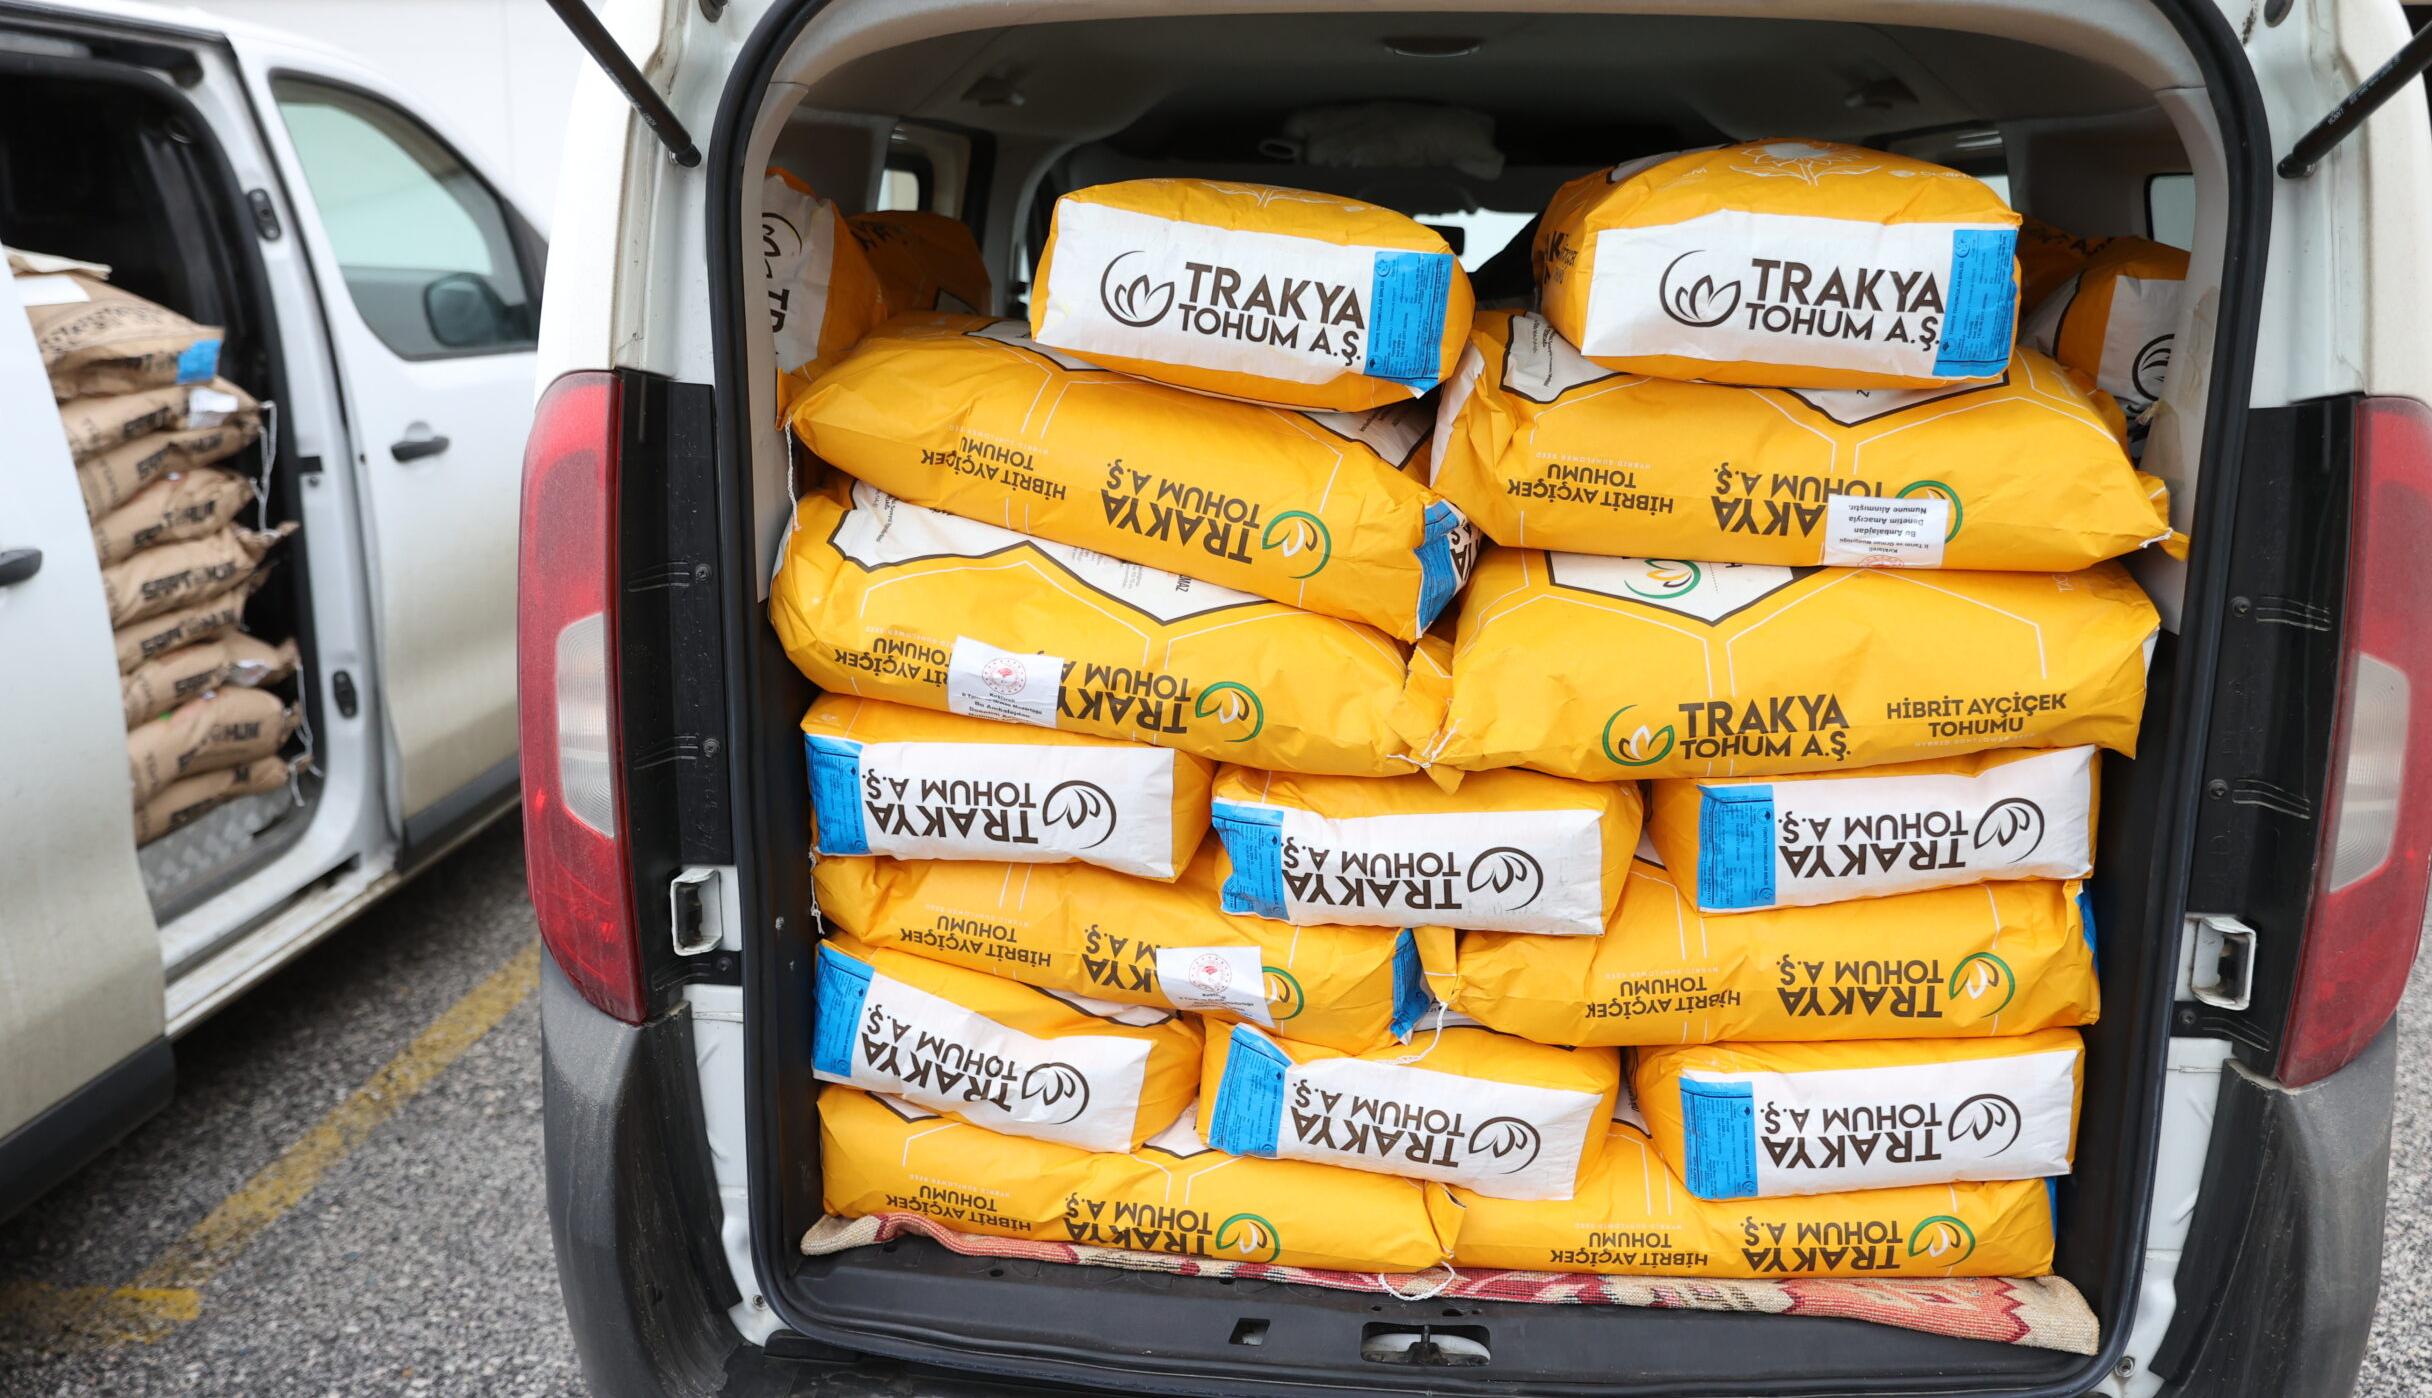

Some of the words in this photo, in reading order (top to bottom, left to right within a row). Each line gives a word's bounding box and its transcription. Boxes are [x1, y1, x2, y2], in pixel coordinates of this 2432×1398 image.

[1185, 261, 1365, 330] TRAKYA
[1751, 258, 1945, 314] TRAKYA
[1178, 303, 1300, 349] TOHUM
[1308, 328, 1361, 367] A.Ş.
[1745, 302, 1875, 341] TOHUM
[1883, 315, 1940, 352] A.Ş.
[920, 449, 999, 481] AYÇİÇEK
[962, 436, 1034, 472] TOHUMU
[1000, 470, 1067, 501] HİBRİT
[1106, 458, 1152, 496] A.Ş.
[1506, 478, 1599, 504] AYÇİÇEK
[1547, 463, 1637, 489] TOHUMU
[1714, 462, 1762, 497] A.Ş.
[1157, 479, 1260, 529] TOHUM
[1599, 491, 1674, 516] HİBRİT
[1711, 495, 1826, 538] AKYA
[1101, 489, 1253, 565] TRAKYA
[834, 648, 922, 680] AYÇİÇEK
[1084, 663, 1192, 702] TOHUM
[1056, 685, 1188, 734] TRAKY
[1678, 694, 1850, 739] TRAKYA
[1887, 695, 1964, 720] HİBRİT
[1967, 691, 2067, 719] AYÇİÇEK
[1927, 716, 2024, 738] TOHUMU
[1679, 735, 1791, 760] TOHUM
[1800, 730, 1851, 762] A.Ş.
[862, 768, 910, 802] A.Ş.
[921, 779, 1037, 809] TOHUM
[865, 800, 1039, 845] TRAKYA
[1778, 810, 1832, 844] A.Ş.
[1844, 810, 1969, 841] TOHUM
[1283, 836, 1330, 872] A.Ş.
[1341, 851, 1462, 879] TOHUM
[1778, 837, 1967, 879] TRAKYA
[1282, 869, 1463, 910] TRAKYA
[900, 928, 984, 954] AYÇİÇEK
[937, 915, 1017, 943] TOHUMU
[1085, 924, 1129, 958] A.Ş.
[985, 943, 1051, 968] HİBRİT
[1776, 954, 1825, 986] A.Ş.
[1620, 976, 1708, 999] TOHUMU
[1835, 959, 1944, 985] TOHUM
[1585, 996, 1672, 1020] AYÇİÇEK
[1674, 990, 1741, 1014] HİBRİT
[1777, 985, 1943, 1018] TRAKYA
[867, 1006, 912, 1043] A.Ş.
[861, 1032, 1012, 1113] TRAKYA
[915, 1031, 1018, 1082] TOHUM
[1292, 1079, 1343, 1115] A.Ş.
[1350, 1095, 1466, 1138] TOHUM
[1760, 1101, 1810, 1135] A.Ş.
[1822, 1102, 1943, 1133] TOHUM
[1290, 1106, 1459, 1169] TRAKYA
[1760, 1128, 1942, 1169] TRAKYA
[885, 1194, 966, 1220] AYÇİÇEK
[919, 1185, 998, 1213] TOHUMU
[1064, 1192, 1106, 1221] A.Ş.
[967, 1211, 1032, 1232] HİBRİT
[1114, 1201, 1213, 1236] TOHUM
[1744, 1216, 1786, 1247] A.Ş.
[1797, 1220, 1903, 1246] TOHUM
[1589, 1232, 1672, 1249] TOHUMU
[1550, 1248, 1637, 1268] AYÇİÇEK
[1639, 1252, 1708, 1269] HİBRİT
[1742, 1245, 1901, 1273] TRAKYA
